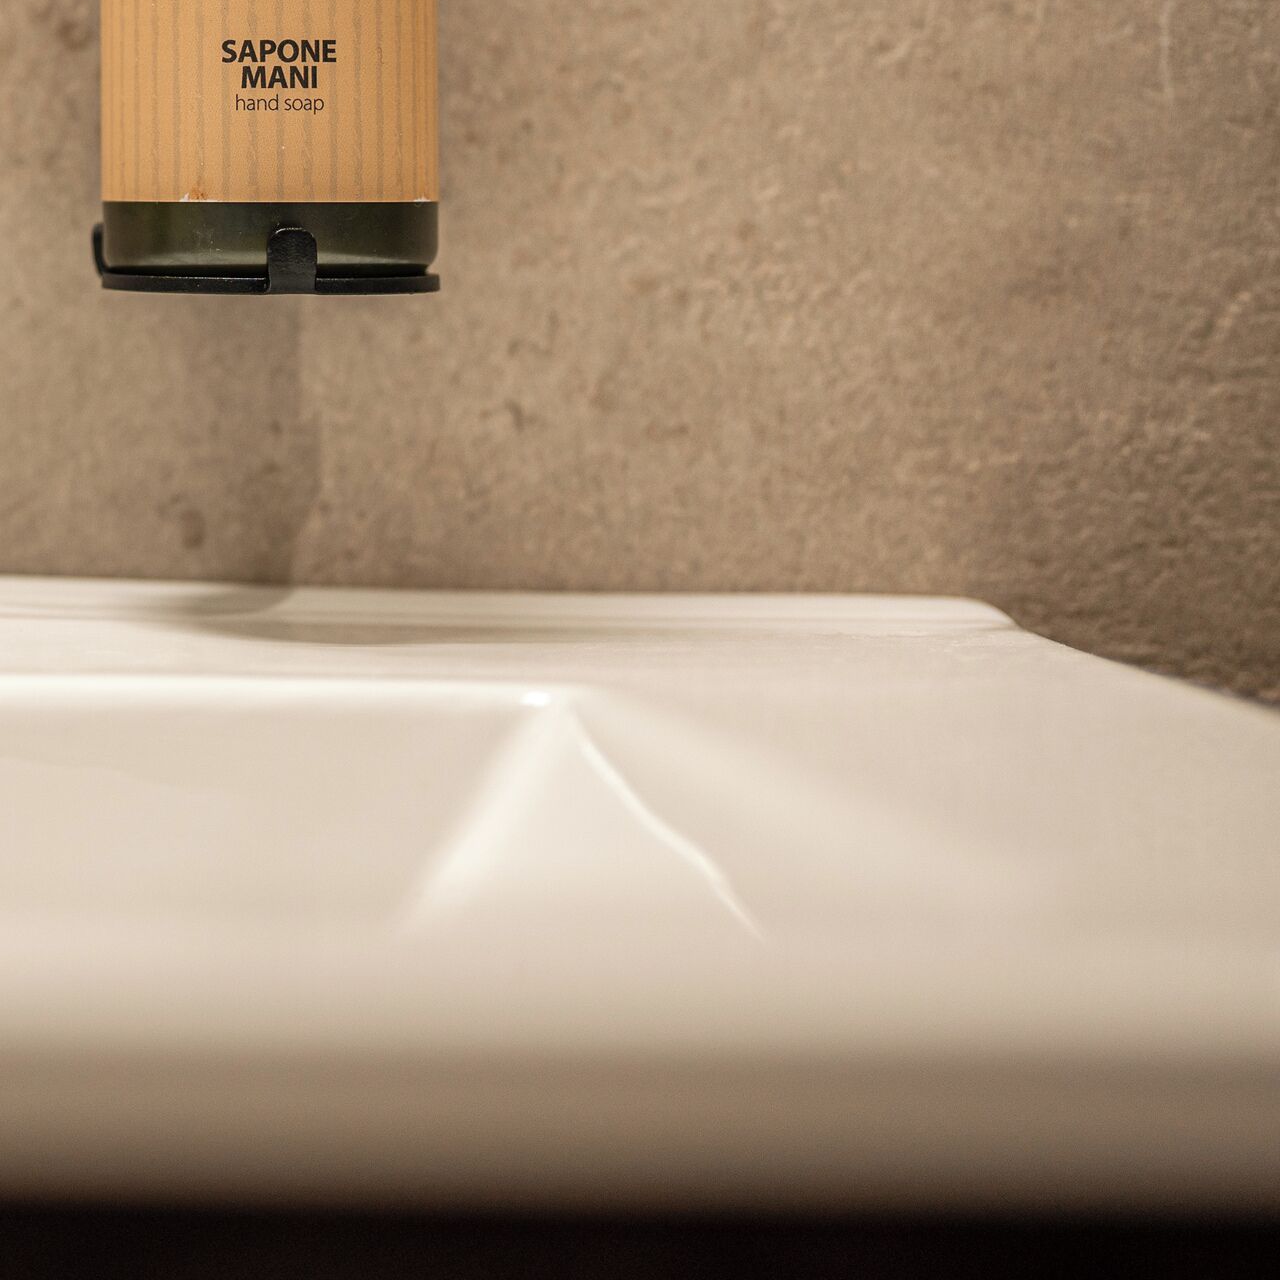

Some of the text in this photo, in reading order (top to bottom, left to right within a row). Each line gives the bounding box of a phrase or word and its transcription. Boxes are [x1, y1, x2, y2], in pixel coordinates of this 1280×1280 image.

[221, 39, 337, 63] SAPONE
[241, 65, 318, 89] MANI
[235, 93, 325, 115] hand soap
